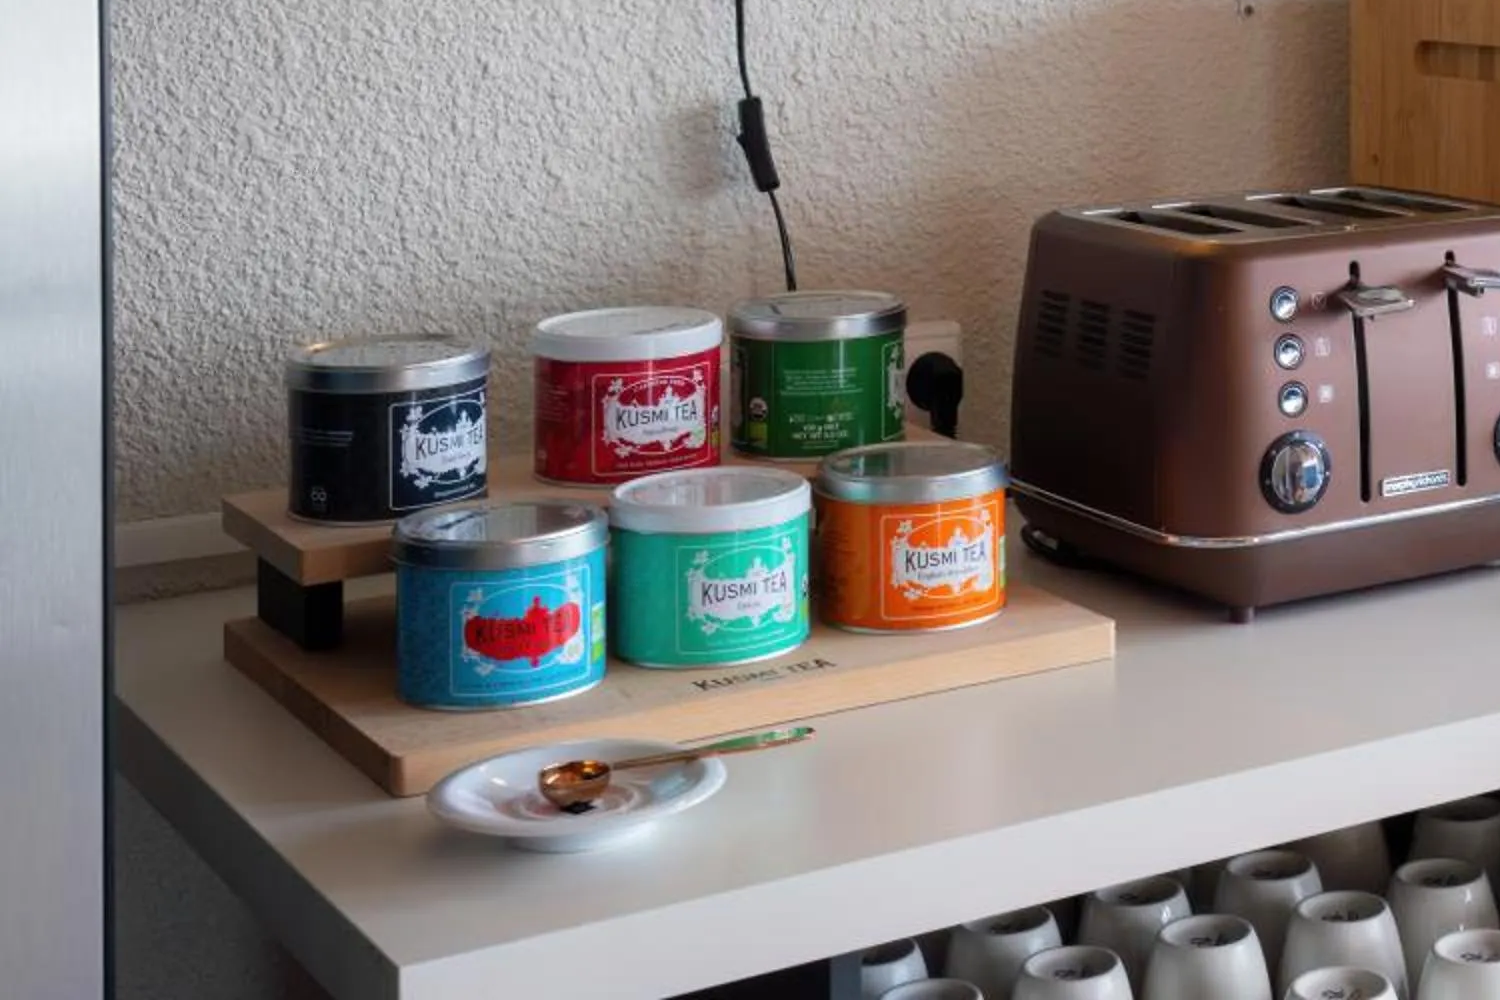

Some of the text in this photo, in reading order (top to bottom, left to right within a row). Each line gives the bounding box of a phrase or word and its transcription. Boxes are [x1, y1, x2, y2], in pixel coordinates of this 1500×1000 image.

[616, 399, 697, 431] KUSMI TEA
[415, 432, 464, 461] KUSMI
[905, 549, 957, 573] KUSMI
[963, 541, 985, 561] TEA
[701, 570, 787, 606] KUSMI TEA
[475, 623, 537, 645] KUSMI
[692, 657, 836, 692] KUSMI TEA
